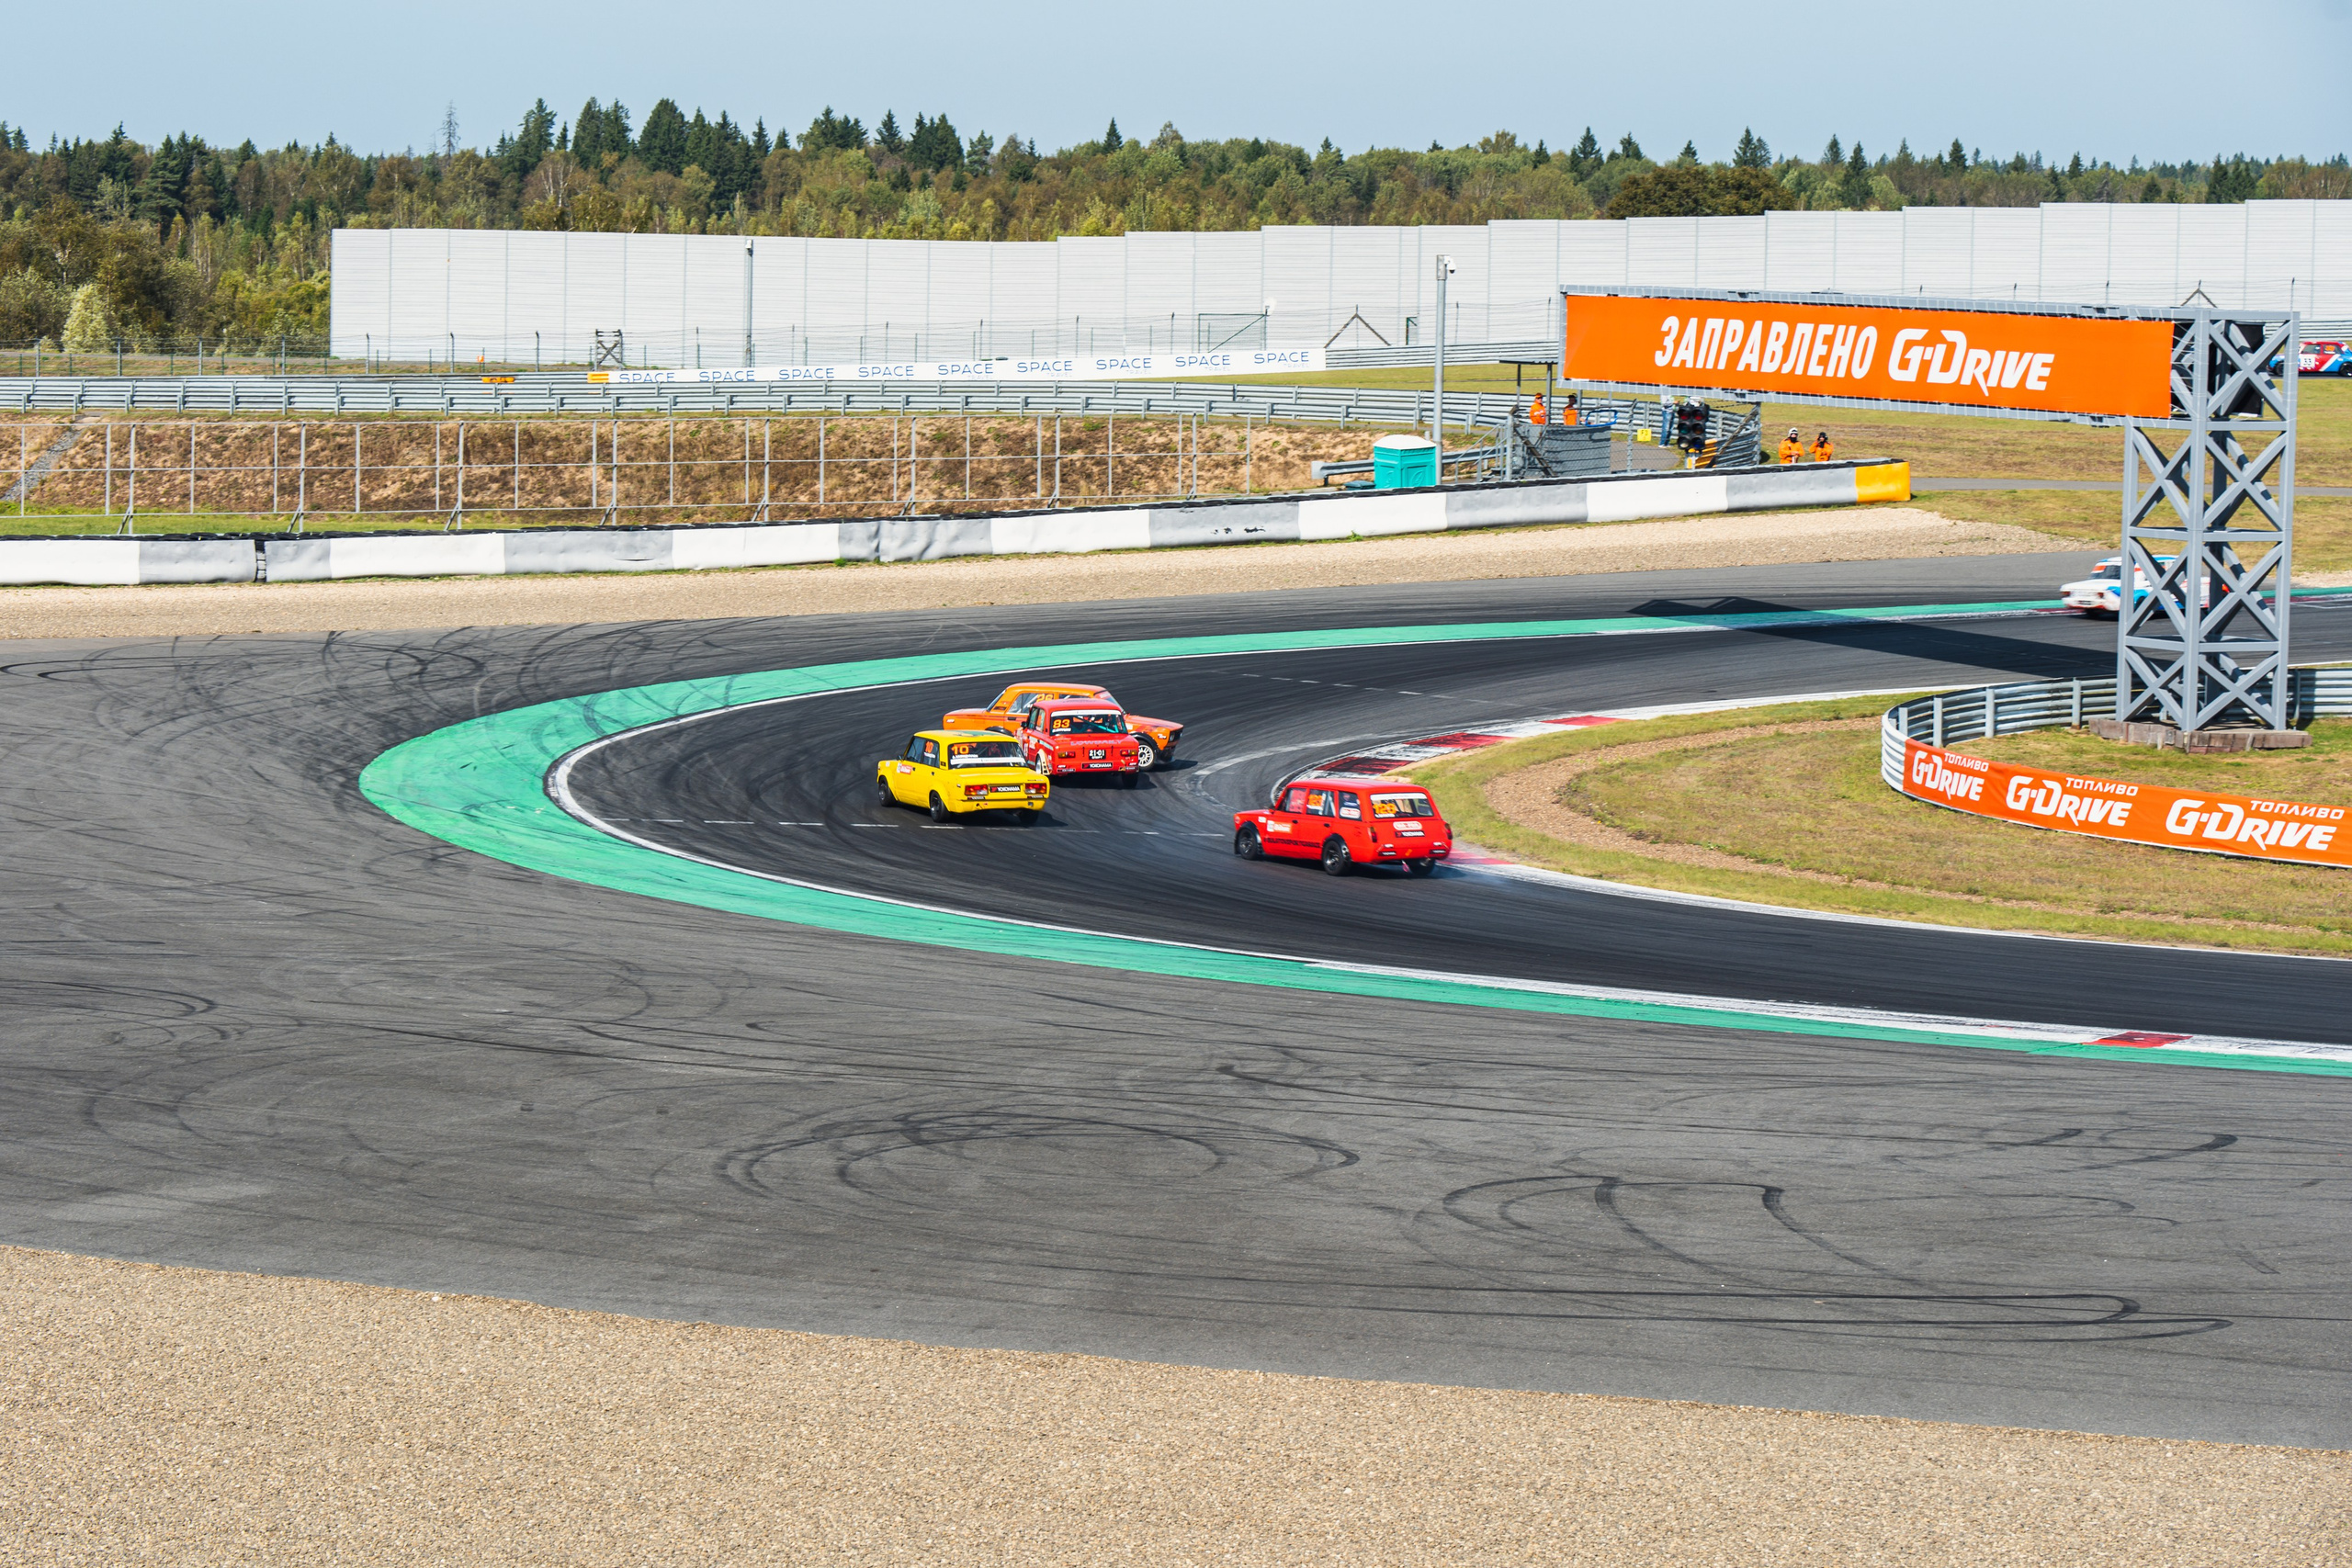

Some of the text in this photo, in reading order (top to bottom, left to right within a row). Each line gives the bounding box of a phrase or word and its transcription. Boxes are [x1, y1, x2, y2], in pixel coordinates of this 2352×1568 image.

[1654, 315, 1878, 379] ЗАПРАВЛЕНО
[1096, 357, 1152, 370] SPACE
[1175, 355, 1231, 367] SPACE
[1254, 351, 1310, 365] SPACE
[858, 366, 914, 378] SPACE
[937, 363, 994, 376] SPACE
[1017, 360, 1073, 373] SPACE
[618, 372, 675, 383] SPACE
[698, 370, 755, 382] SPACE
[778, 368, 835, 380] SPACE
[1052, 718, 1070, 729] 83
[924, 740, 934, 753] 10
[951, 745, 969, 755] 10
[1944, 752, 1989, 773] ТОПЛИВО
[2065, 777, 2139, 796] ТОПЛИВО
[1373, 803, 1396, 815] 123
[2250, 800, 2345, 820] ТОПЛИВО
